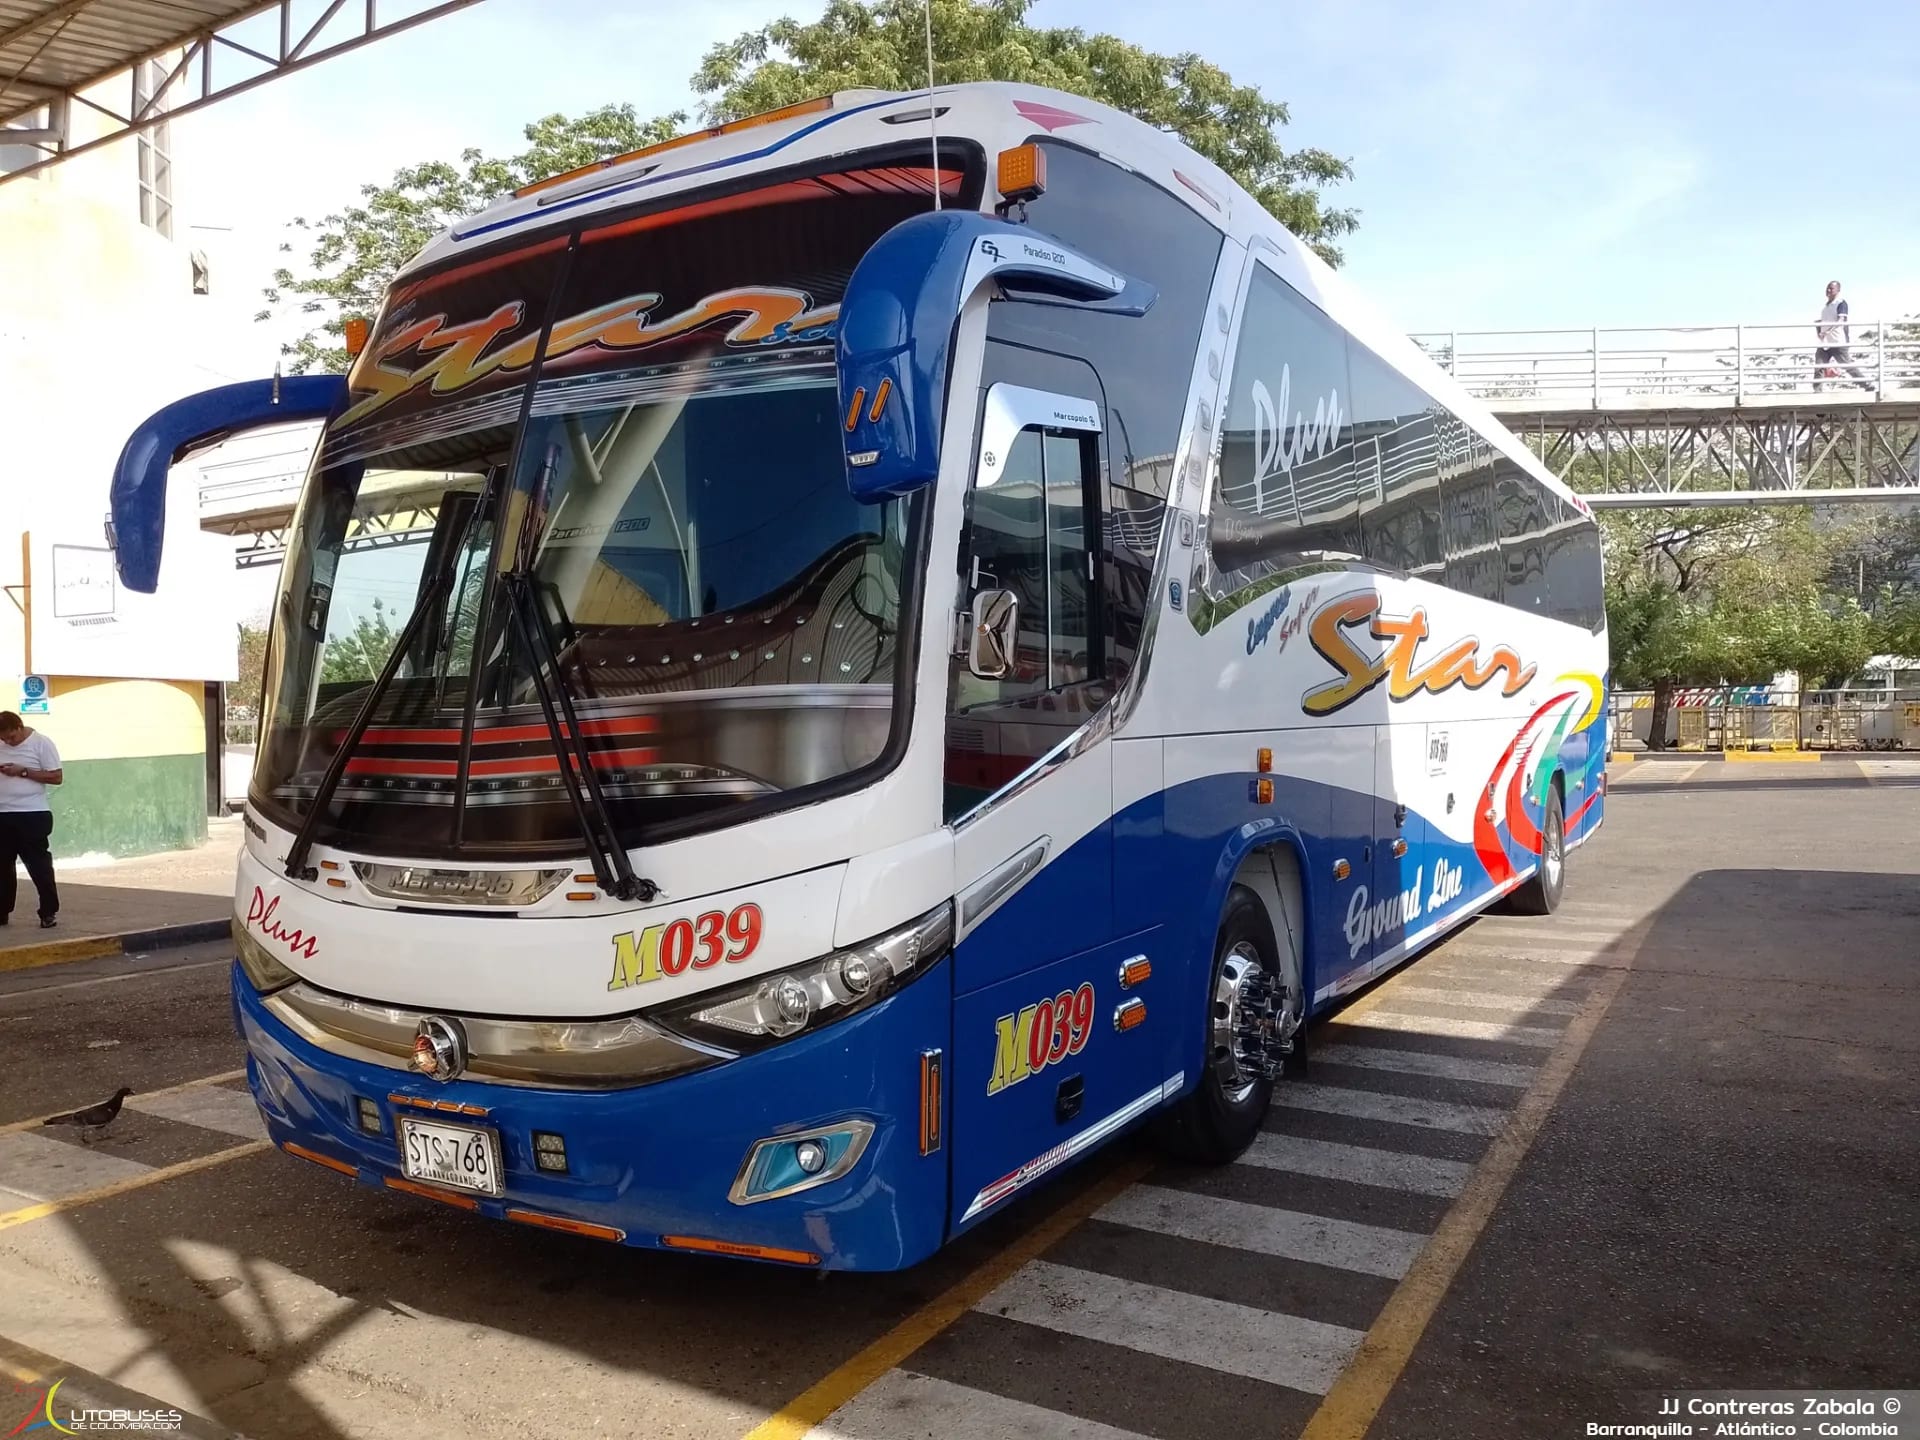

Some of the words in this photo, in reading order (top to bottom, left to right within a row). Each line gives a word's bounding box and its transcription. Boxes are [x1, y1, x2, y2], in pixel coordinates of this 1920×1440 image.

[1023, 244, 1052, 261] Paradiso
[1051, 251, 1066, 264] 1200
[1053, 411, 1088, 423] Marcopolo
[1301, 587, 1537, 717] Star
[389, 868, 514, 894] Marcopolo
[1343, 885, 1422, 960] Ground
[1427, 857, 1463, 913] Line
[247, 886, 320, 960] Pluss
[607, 902, 764, 992] M039
[987, 981, 1095, 1097] M039
